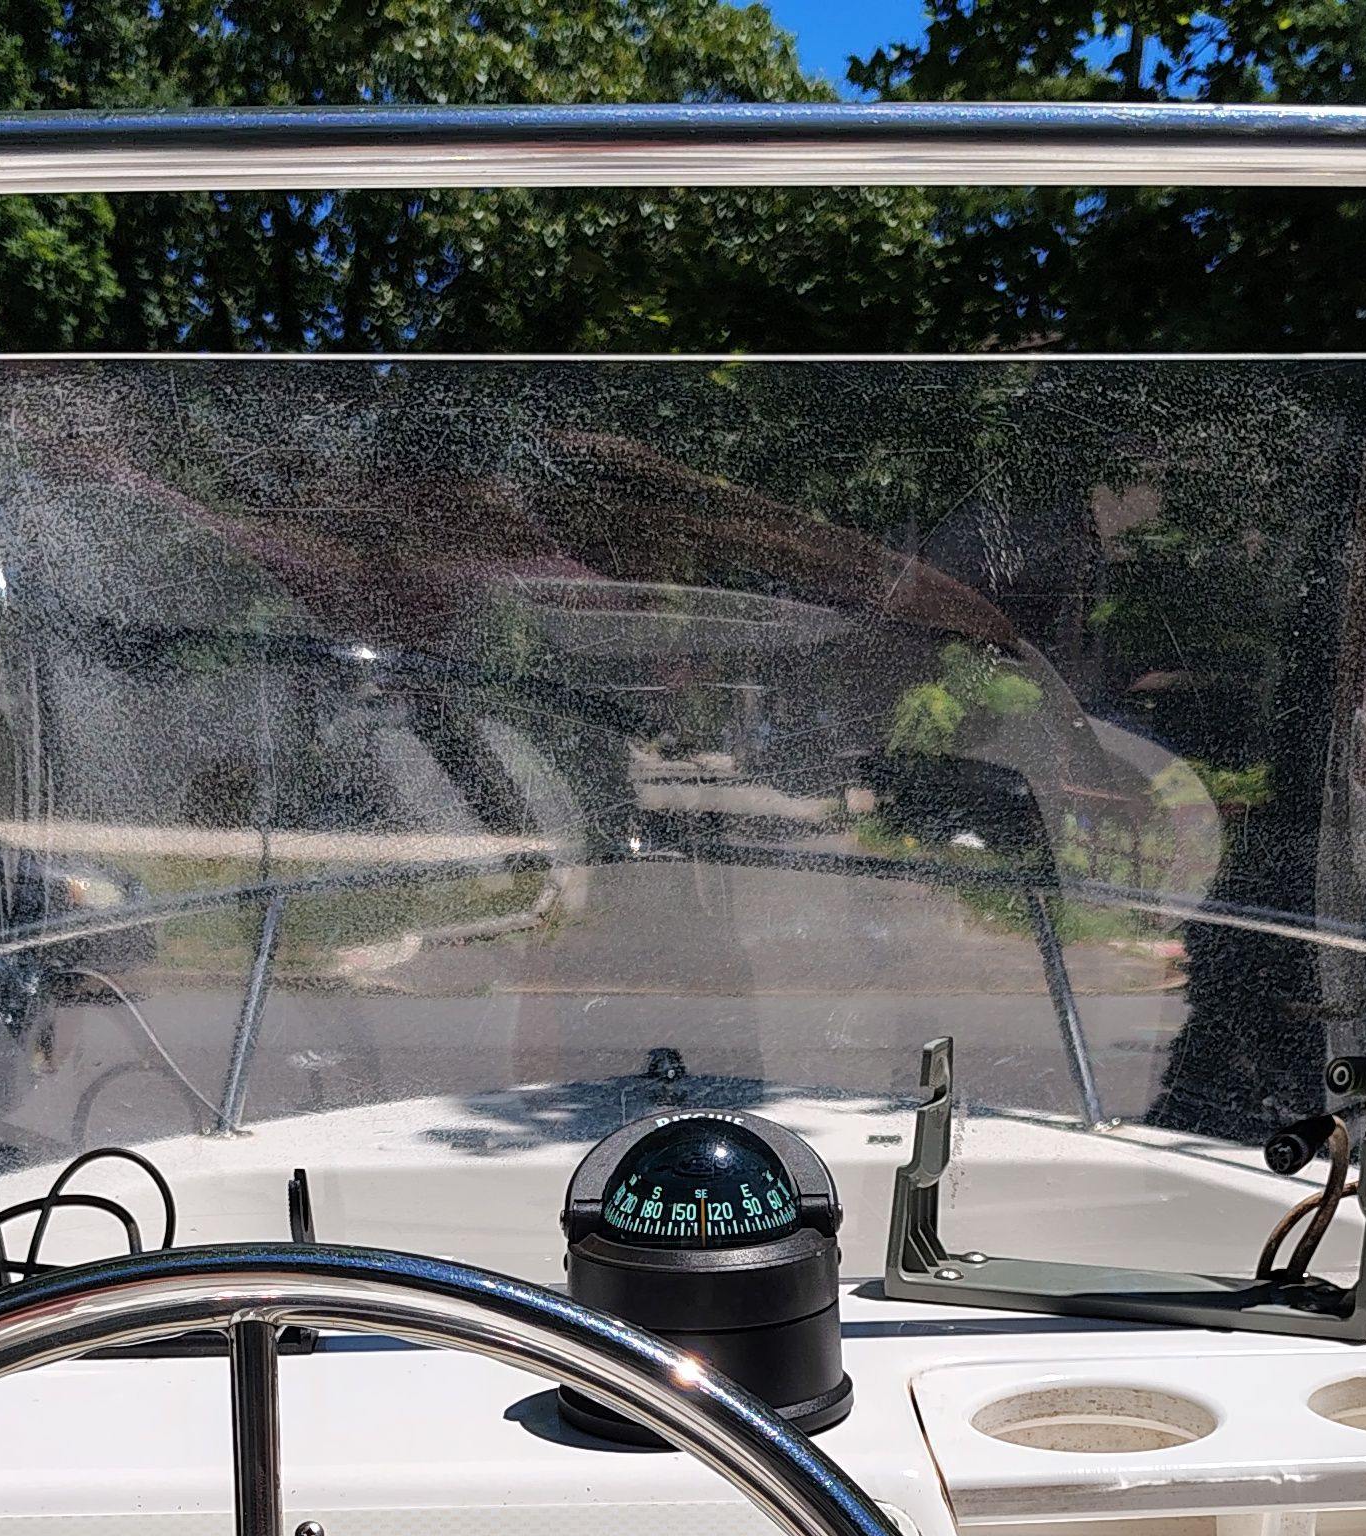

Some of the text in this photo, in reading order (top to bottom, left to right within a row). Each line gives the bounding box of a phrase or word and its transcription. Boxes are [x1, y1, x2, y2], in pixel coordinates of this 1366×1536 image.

[652, 1186, 663, 1199] S
[695, 1189, 708, 1199] SE
[740, 1183, 753, 1197] E
[742, 1197, 763, 1216] 90
[766, 1189, 783, 1210] 60
[640, 1199, 663, 1219] 180
[671, 1204, 697, 1221] 150
[707, 1203, 733, 1221] 120
